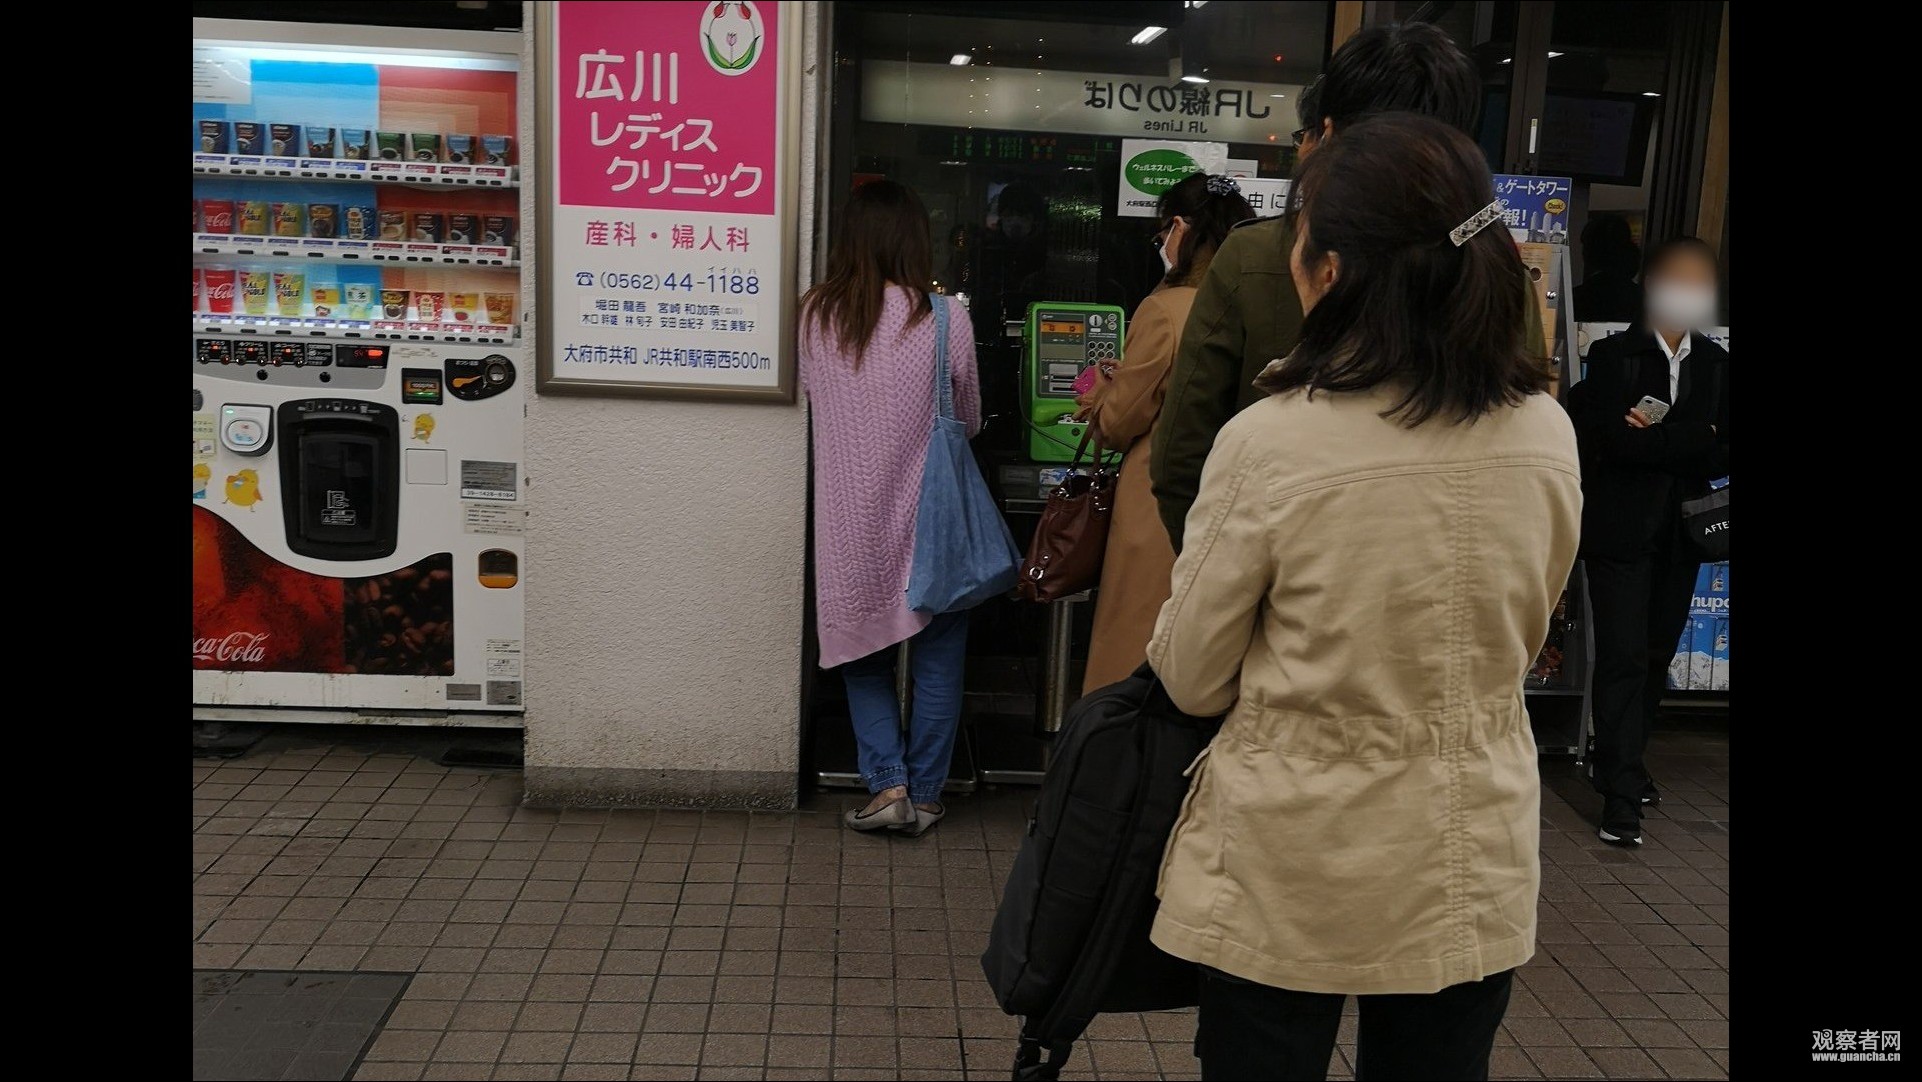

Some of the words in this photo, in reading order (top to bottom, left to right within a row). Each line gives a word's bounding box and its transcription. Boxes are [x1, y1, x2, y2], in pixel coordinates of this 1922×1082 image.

[575, 48, 679, 104] 広川
[590, 111, 718, 153] レディス
[606, 155, 763, 198] クリニック
[1502, 208, 1527, 226] 報!
[586, 219, 750, 252] 産科・婦人科
[600, 271, 759, 294] (0562)44-1188
[564, 344, 637, 365] 大府市共和
[643, 348, 771, 370] JR共和駅南西500m
[1704, 520, 1730, 536] AFTE
